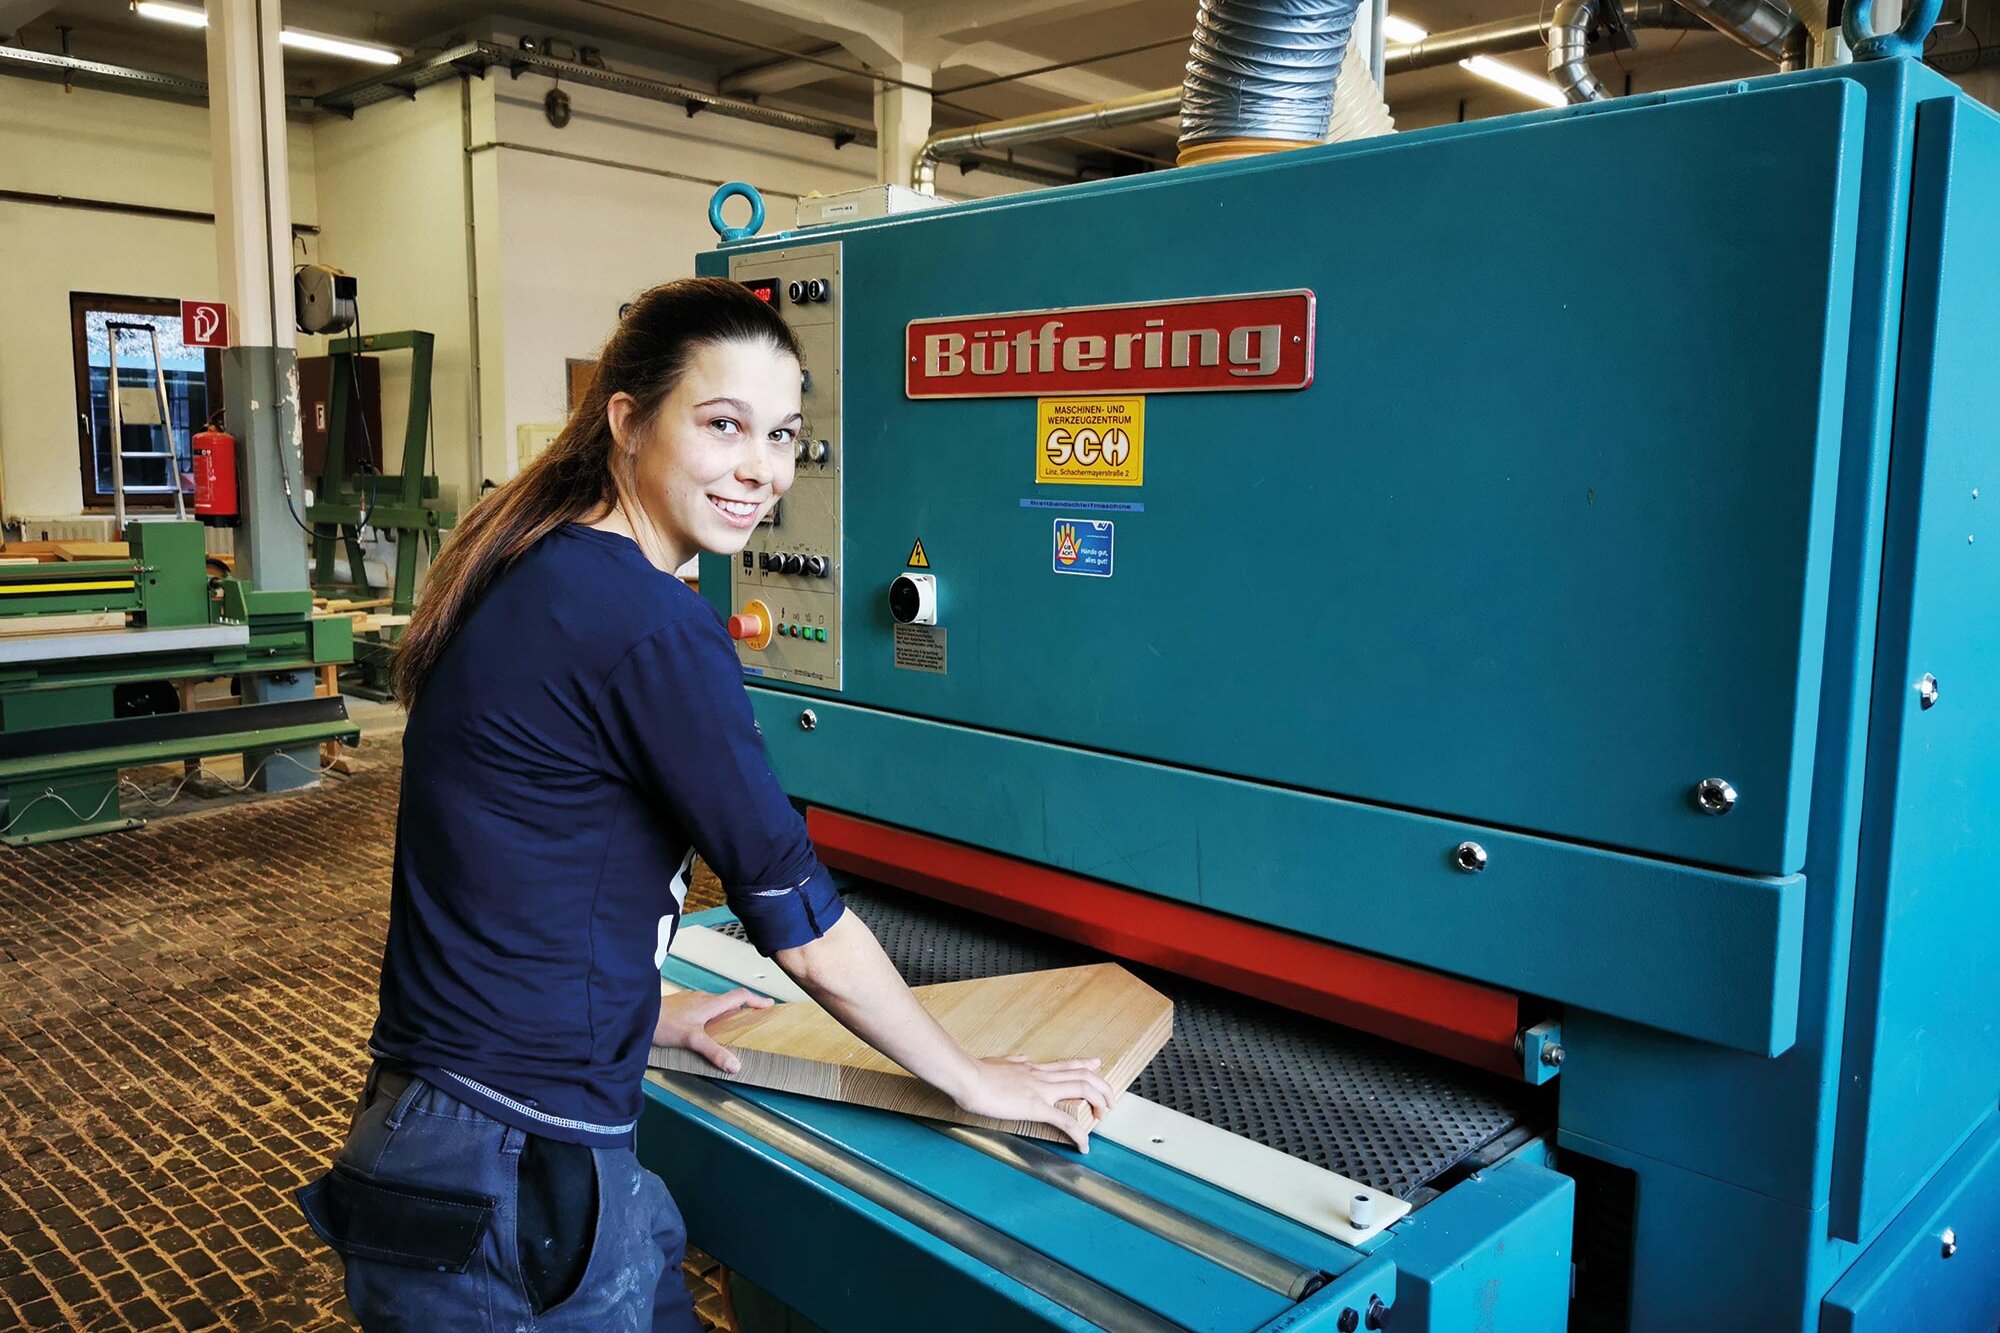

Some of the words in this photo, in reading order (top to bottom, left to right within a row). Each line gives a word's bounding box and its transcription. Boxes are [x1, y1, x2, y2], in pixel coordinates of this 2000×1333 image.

[924, 319, 1282, 377] Bütfering
[1054, 405, 1105, 414] MASCHINEN-
[1107, 405, 1125, 414] UND
[1048, 416, 1132, 425] WERKZEUGZENTRUM
[1046, 427, 1130, 467] SCH
[1060, 468, 1124, 477] Schachermayerstraße
